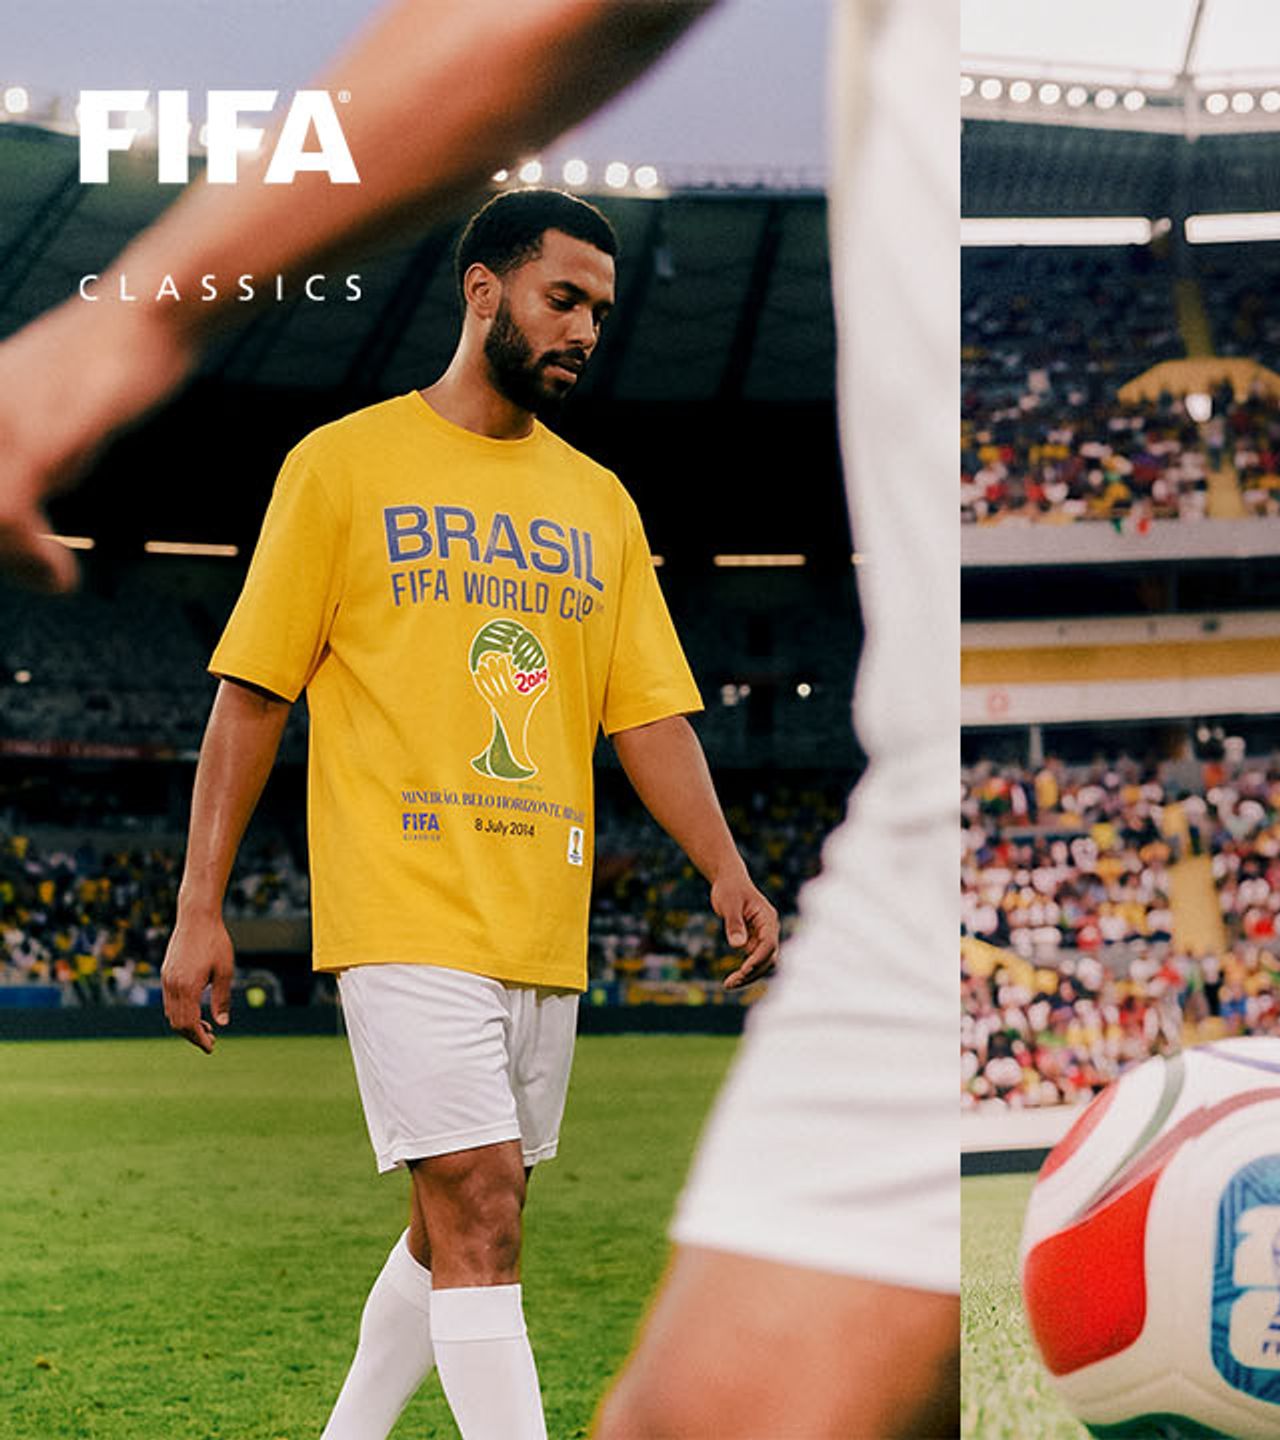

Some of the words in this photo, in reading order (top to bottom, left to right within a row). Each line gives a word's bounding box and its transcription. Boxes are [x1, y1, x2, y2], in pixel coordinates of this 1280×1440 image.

[383, 505, 604, 592] BRASIL
[391, 569, 450, 607] FIFA
[463, 570, 549, 615] WORLD
[402, 812, 441, 831] FIFA
[474, 818, 483, 832] 8
[484, 820, 508, 837] July
